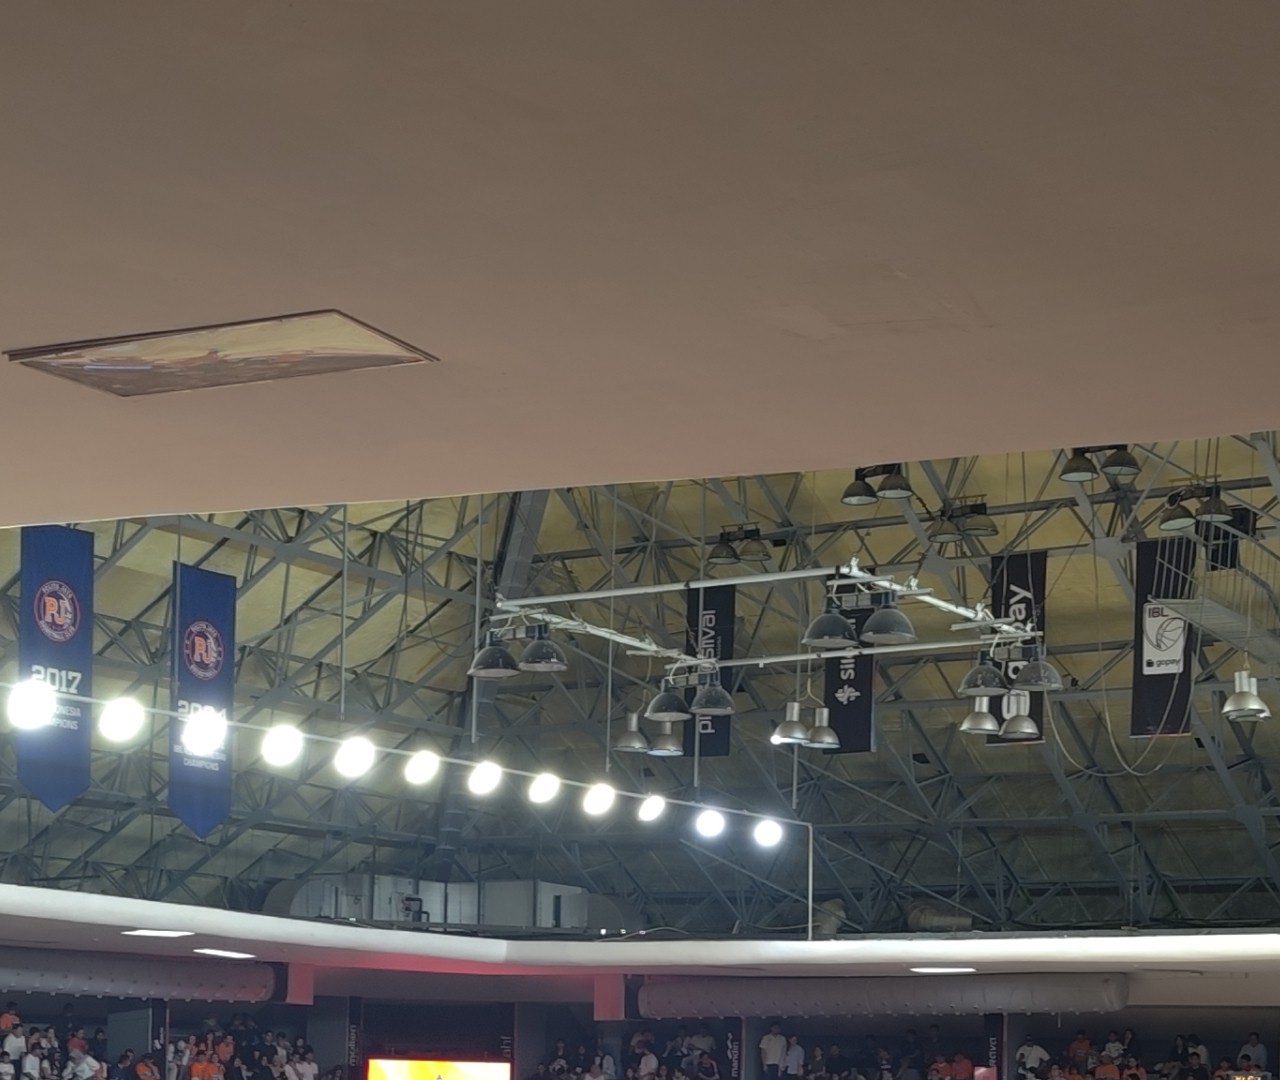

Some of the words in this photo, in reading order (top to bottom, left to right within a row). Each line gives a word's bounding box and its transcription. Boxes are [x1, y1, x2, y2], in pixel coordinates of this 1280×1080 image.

[1148, 607, 1169, 619] IBL
[1155, 658, 1182, 669] gopay
[31, 664, 82, 694] 2017
